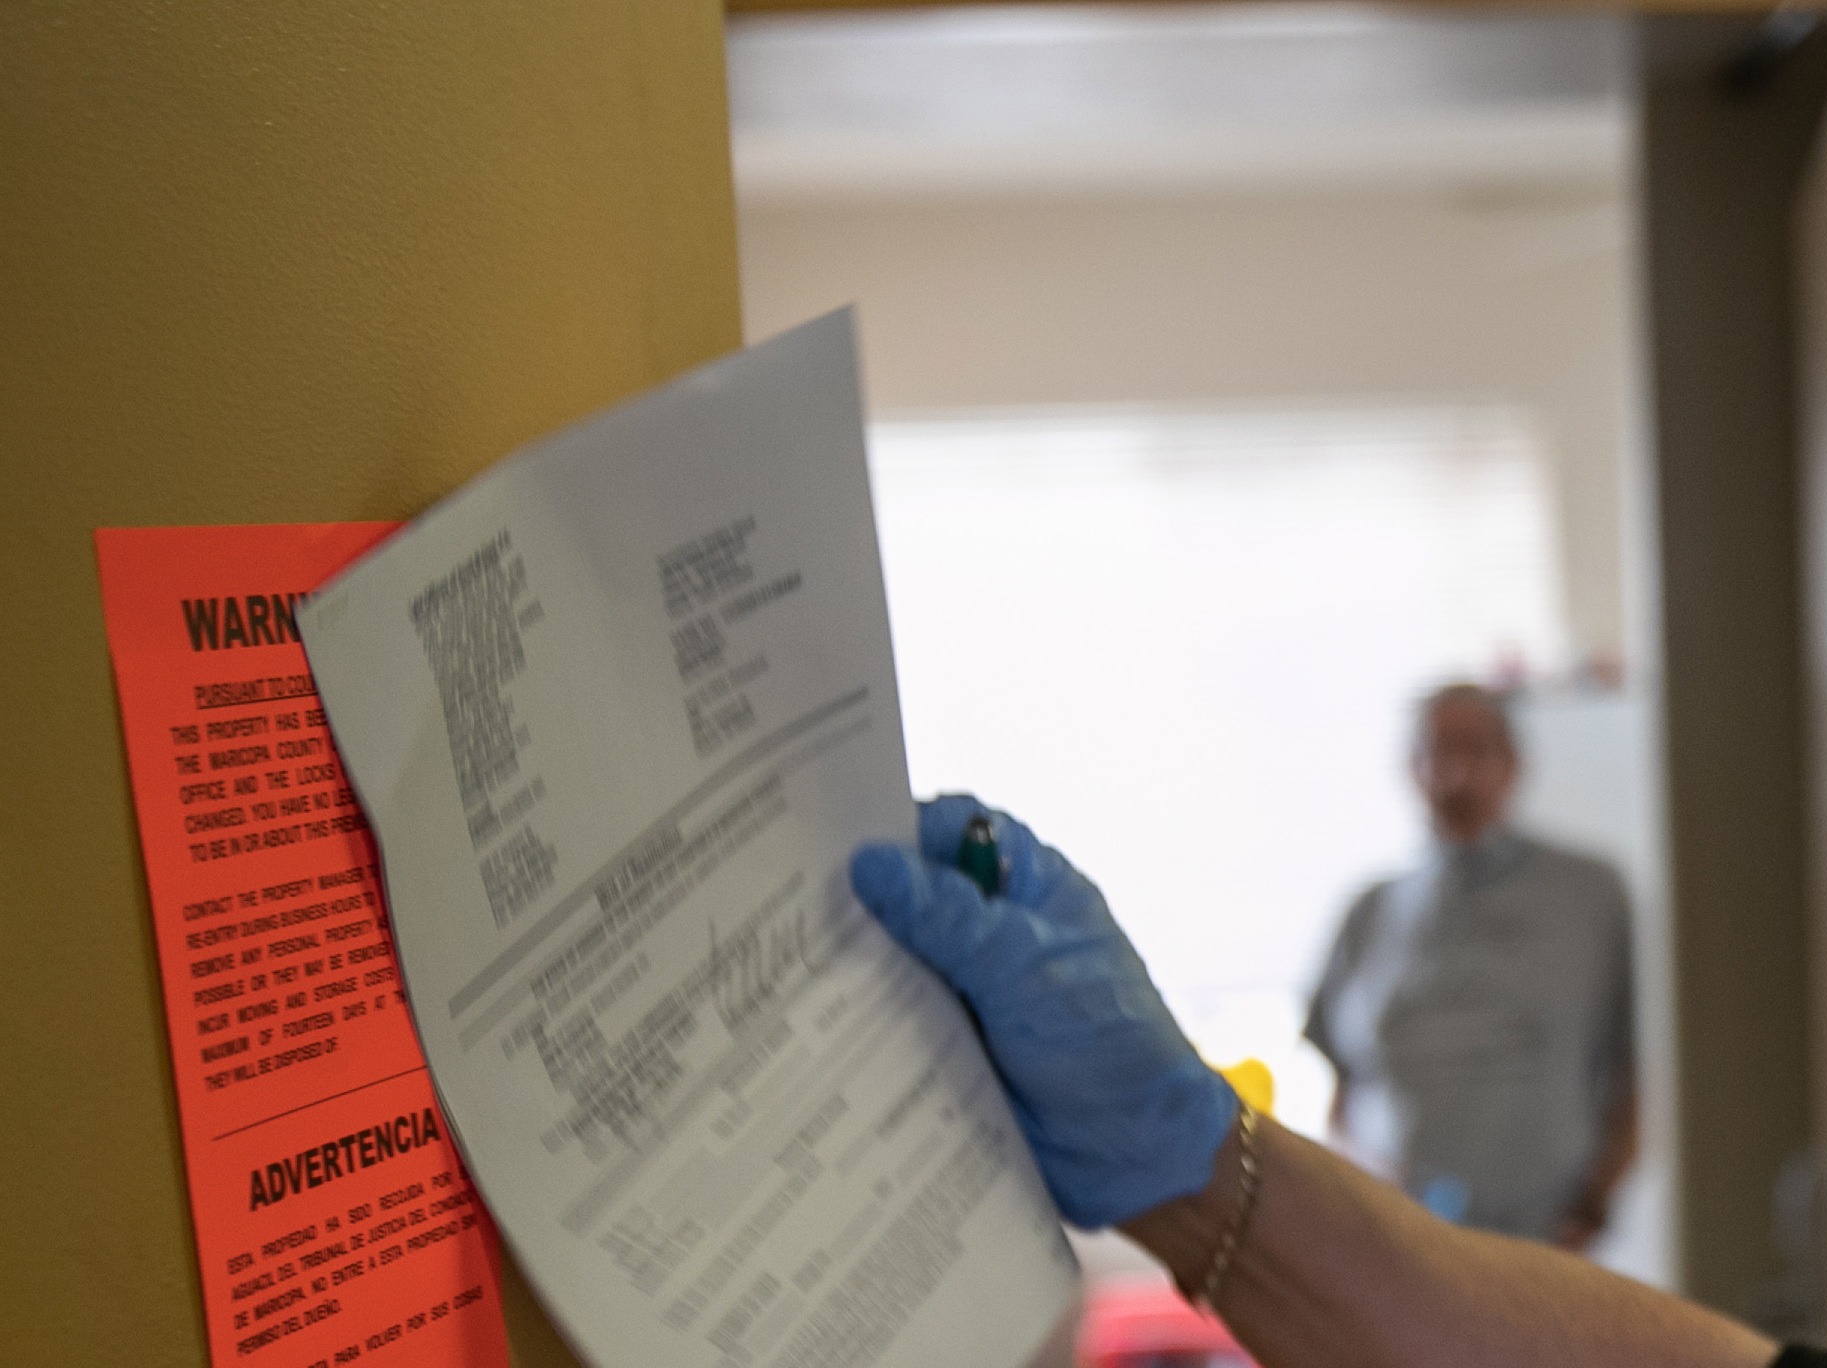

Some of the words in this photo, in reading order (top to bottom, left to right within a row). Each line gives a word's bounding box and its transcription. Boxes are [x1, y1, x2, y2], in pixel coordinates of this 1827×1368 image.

[182, 591, 318, 652] WARN
[207, 715, 269, 742] PROPERTY
[209, 745, 271, 771] MARICOPA
[277, 737, 323, 761] COUNTY
[180, 781, 225, 805] OFFICE
[235, 775, 259, 797] AND
[265, 770, 290, 790] THE
[296, 763, 338, 786] LOCKS
[210, 840, 227, 860] BE
[263, 823, 302, 849] ABOUT
[183, 896, 233, 922] CONTACT
[261, 878, 315, 903] PROPERTY
[241, 914, 279, 939] DURING
[281, 902, 328, 928] BUSINESS
[267, 933, 321, 959] PERSONAL
[326, 919, 373, 944] PROPERTY
[194, 979, 246, 1008] POSSIBLE
[330, 953, 344, 971] BE
[314, 976, 358, 1003] STORAGE
[283, 1010, 335, 1038] FOURTEEN
[274, 1041, 323, 1070] DISPOSED
[250, 1108, 441, 1213] ADVERTENCIA
[299, 1241, 349, 1272] TRIBUNAL
[332, 1259, 366, 1287] ENTRE
[380, 1244, 404, 1266] ESTA
